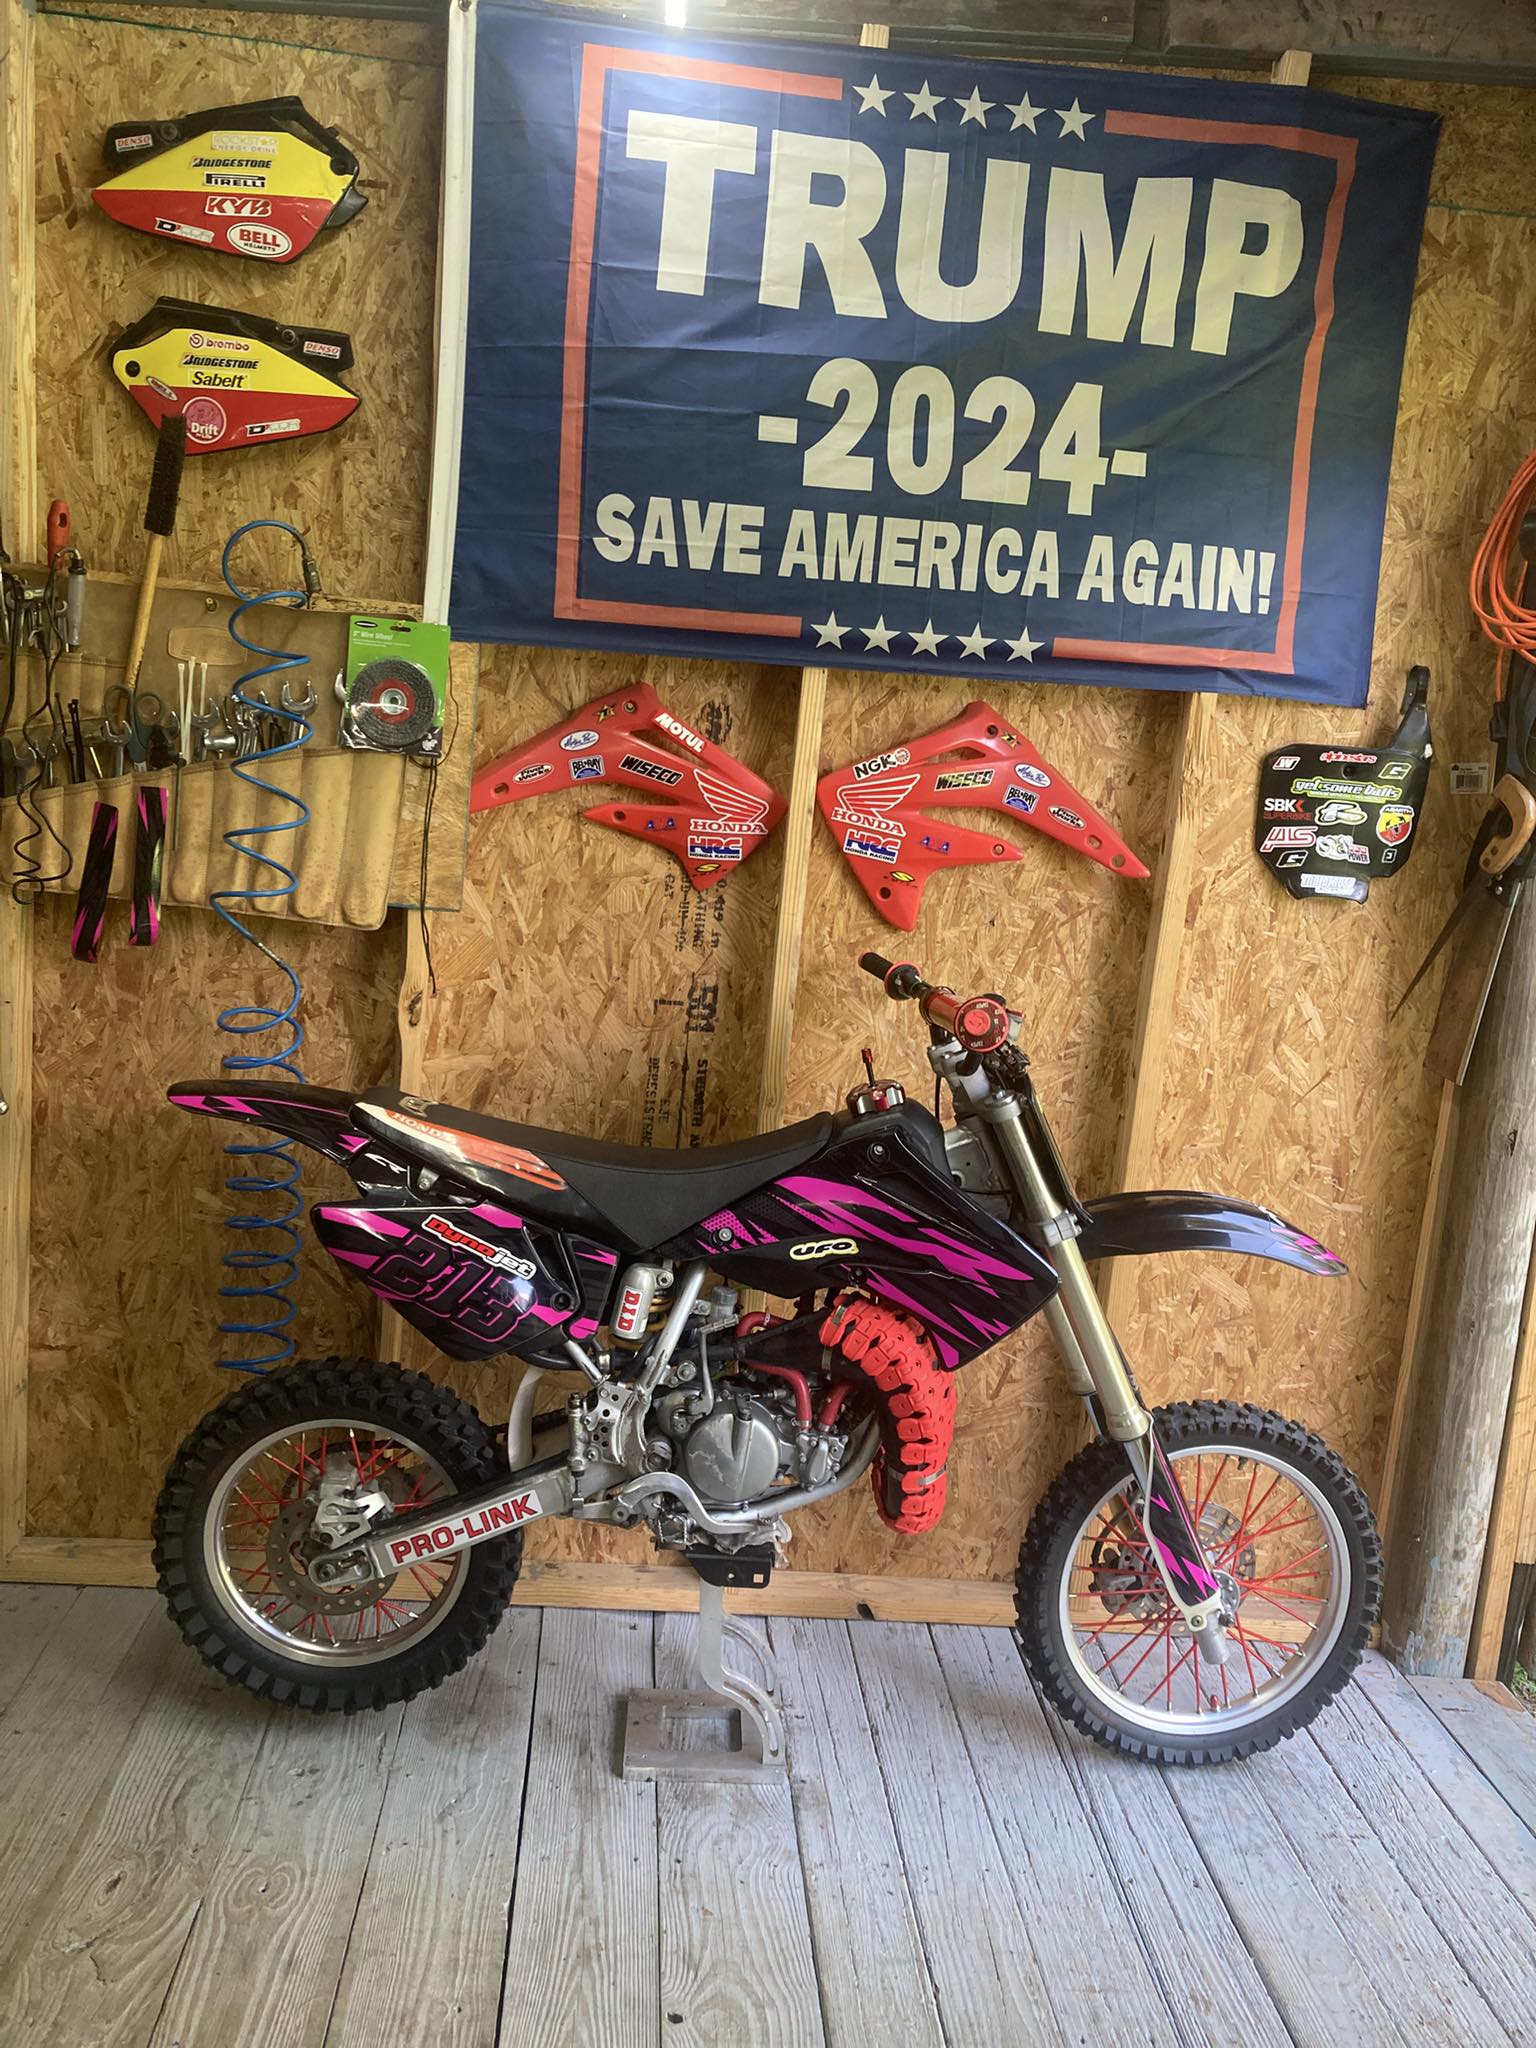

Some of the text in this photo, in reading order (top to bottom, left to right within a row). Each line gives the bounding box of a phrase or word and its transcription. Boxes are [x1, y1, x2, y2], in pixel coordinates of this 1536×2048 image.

[117, 134, 151, 147] DENSO
[192, 158, 272, 168] BRIDGESTONE
[205, 173, 266, 188] PIRELLI
[240, 229, 281, 247] BELL
[625, 109, 1304, 355] TRUMP
[244, 242, 276, 252] HELMETS
[206, 339, 250, 352] brembo
[305, 342, 341, 354] DENSO
[183, 354, 259, 370] BRIDGESTONE
[192, 371, 244, 389] Sabelt
[191, 422, 219, 436] Drift
[593, 493, 1277, 614] SAVE AMERICA AGAIN!
[655, 713, 704, 752] MOTUL
[620, 755, 682, 785] WISECO
[853, 754, 897, 779] NGK
[935, 770, 994, 790] WISECO
[1264, 798, 1297, 812] SBK
[690, 820, 768, 834] HONDA
[832, 809, 906, 837] HONDA
[689, 837, 742, 855] HRC
[846, 829, 900, 858] HRC
[394, 1112, 458, 1145] HONDA
[425, 1218, 533, 1277] Dynojet
[792, 1240, 858, 1258] UFO
[390, 1493, 539, 1565] PRO-LINK
